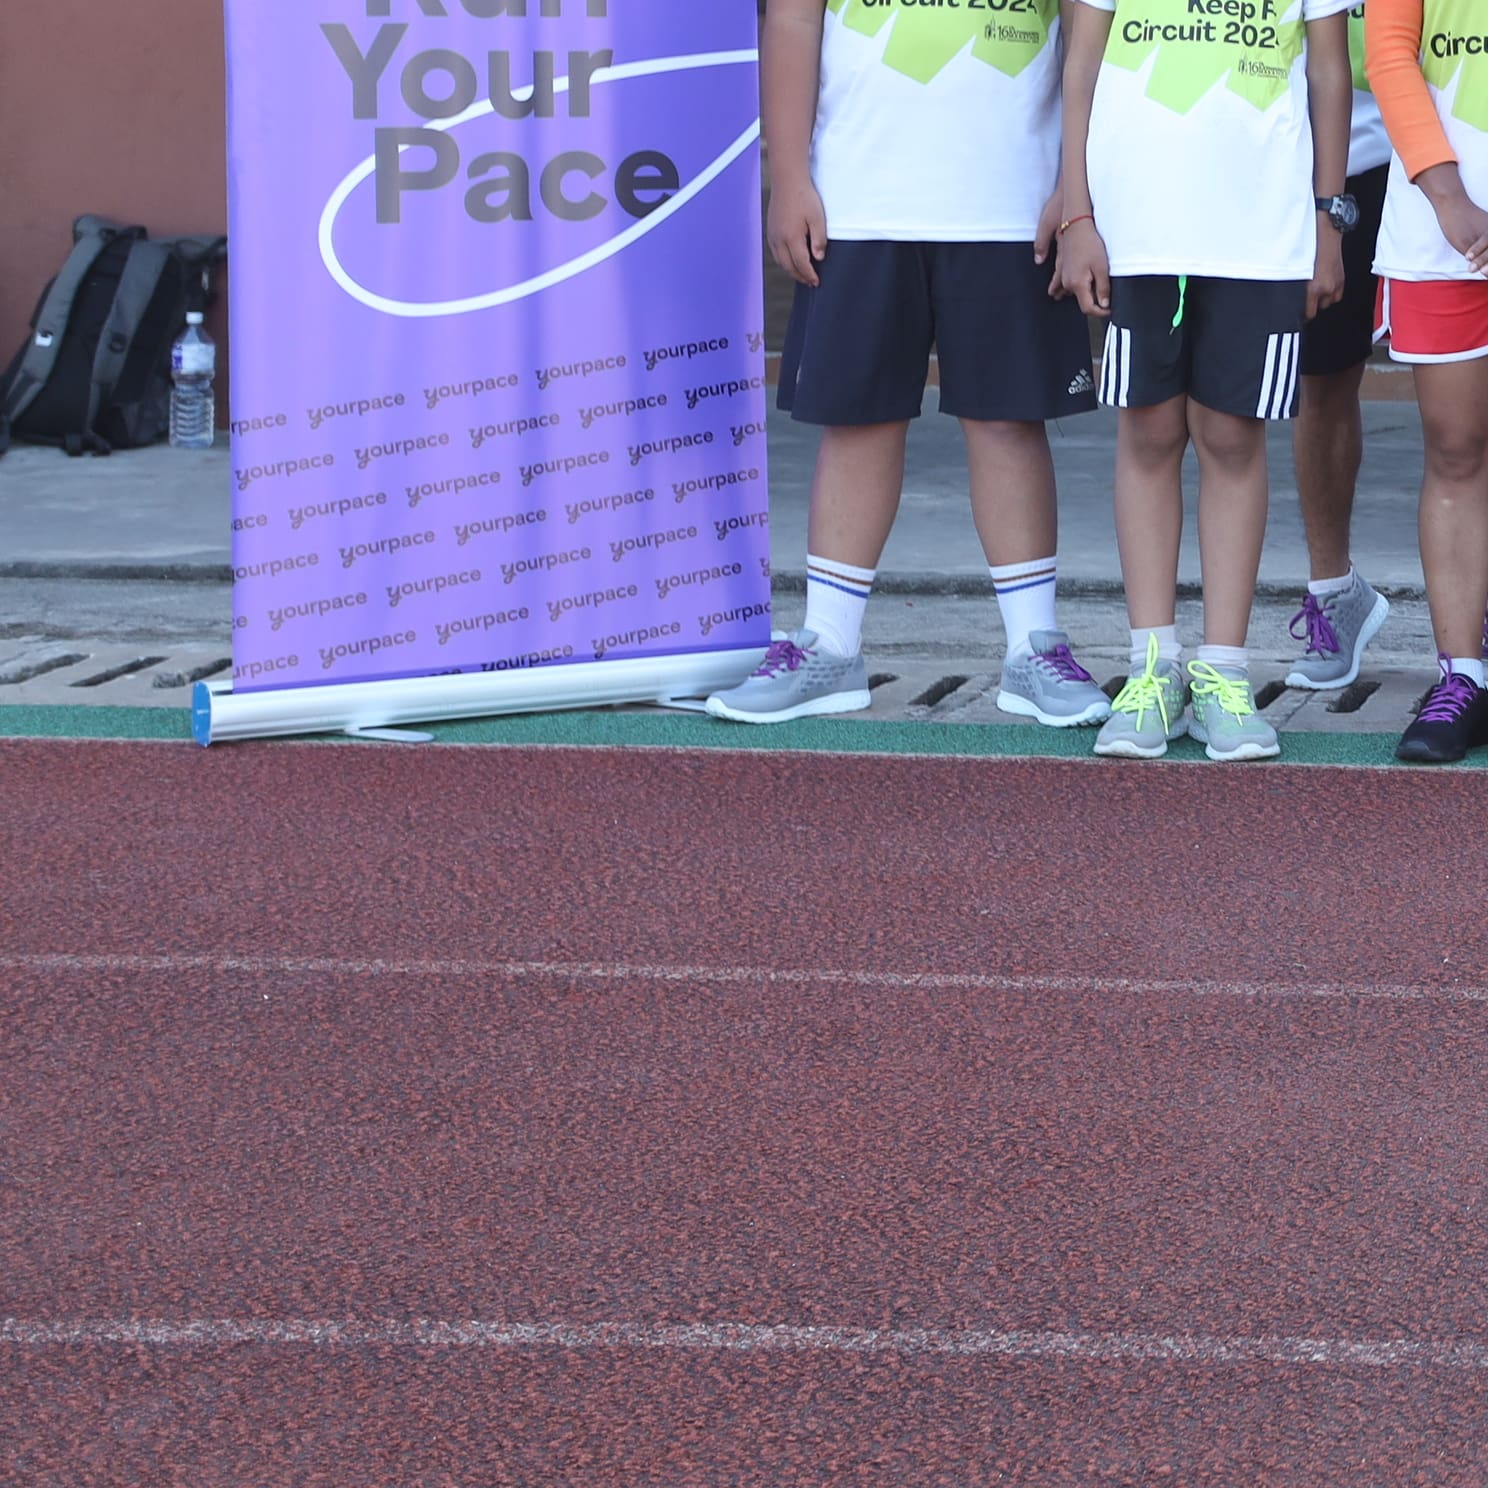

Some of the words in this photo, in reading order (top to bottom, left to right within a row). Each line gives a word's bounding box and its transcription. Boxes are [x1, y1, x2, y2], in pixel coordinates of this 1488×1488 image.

[319, 22, 613, 120] Your
[1122, 20, 1217, 44] Circuit
[374, 127, 680, 224] Pace
[307, 389, 406, 428] yourpace
[423, 371, 519, 408] yourpace
[535, 352, 626, 389] yourpace
[642, 334, 729, 370] yourpace
[234, 451, 334, 490] yourpace
[354, 430, 450, 468] yourpace
[469, 410, 561, 447] yourpace
[578, 391, 668, 427] yourpace
[288, 490, 388, 529] yourpace
[405, 469, 501, 508] yourpace
[519, 448, 610, 486] yourpace
[627, 428, 714, 464] yourpace
[339, 527, 436, 568] yourpace
[454, 507, 547, 545] yourpace
[565, 486, 655, 523] yourpace
[672, 465, 759, 502] yourpace
[268, 589, 368, 630] yourpace
[387, 567, 482, 606] yourpace
[501, 545, 592, 584] yourpace
[609, 524, 698, 561] yourpace
[319, 627, 417, 668] yourpace
[435, 605, 530, 644] yourpace
[547, 582, 639, 621] yourpace
[655, 561, 742, 598] yourpace
[591, 619, 681, 657] yourpace
